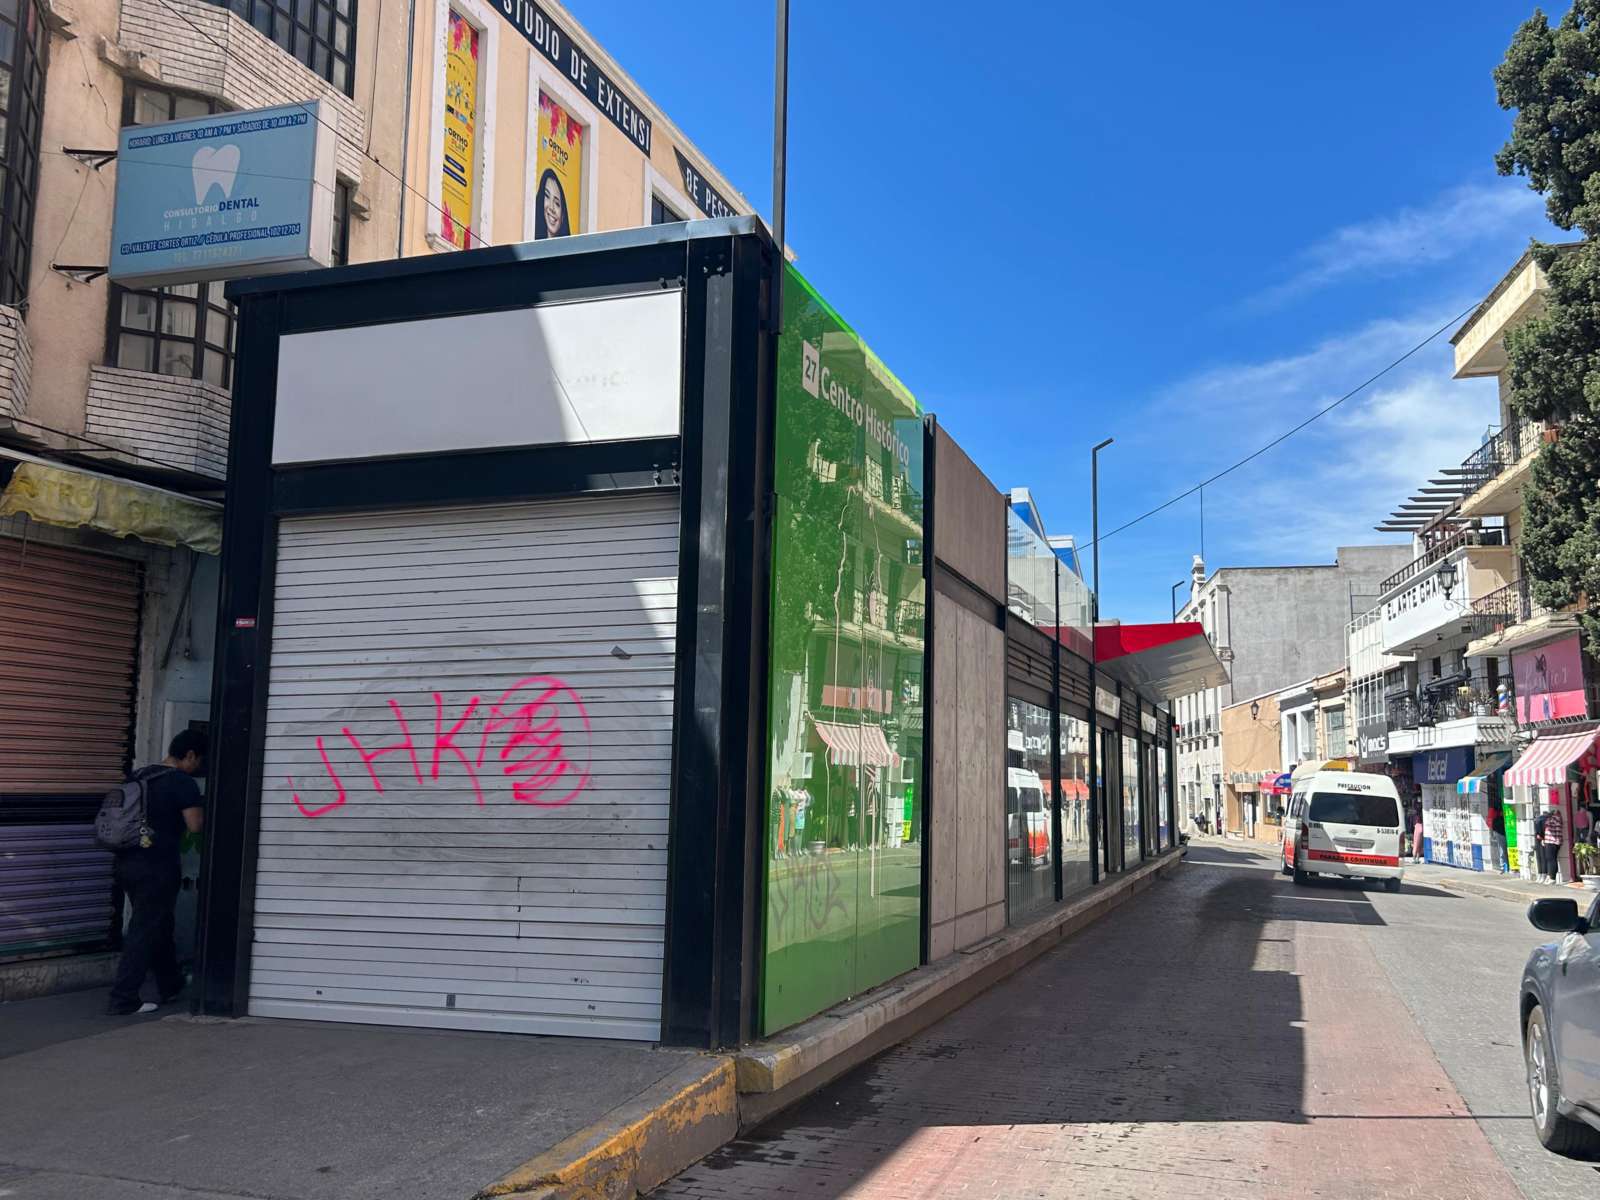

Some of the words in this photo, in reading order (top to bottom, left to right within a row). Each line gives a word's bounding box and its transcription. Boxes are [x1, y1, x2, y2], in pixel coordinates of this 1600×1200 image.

[570, 49, 588, 90] DE
[597, 76, 650, 150] EXTENSI
[549, 138, 569, 161] ORTHO
[686, 167, 699, 200] DE
[218, 198, 260, 211] DENTAL
[229, 228, 268, 240] PROFESIONAL
[805, 354, 816, 384] 27
[821, 366, 863, 426] Centro
[865, 404, 909, 467] Histórico
[1398, 585, 1418, 615] ARTE
[1427, 751, 1449, 780] telcel
